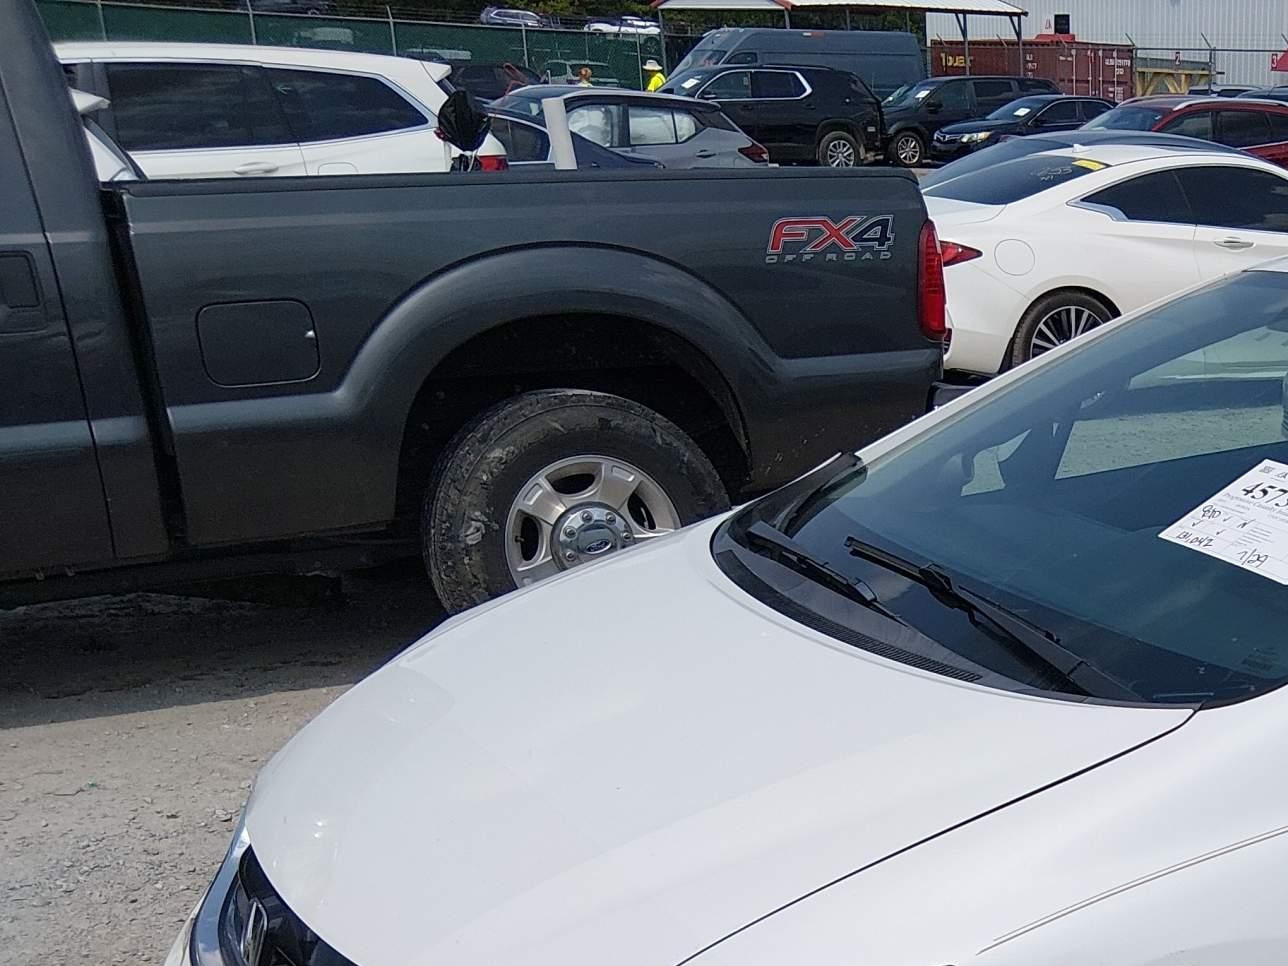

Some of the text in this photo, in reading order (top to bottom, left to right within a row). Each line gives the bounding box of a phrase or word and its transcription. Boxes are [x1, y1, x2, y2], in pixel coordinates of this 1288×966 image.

[767, 215, 895, 254] FX4
[766, 251, 893, 263] OFF ROAD
